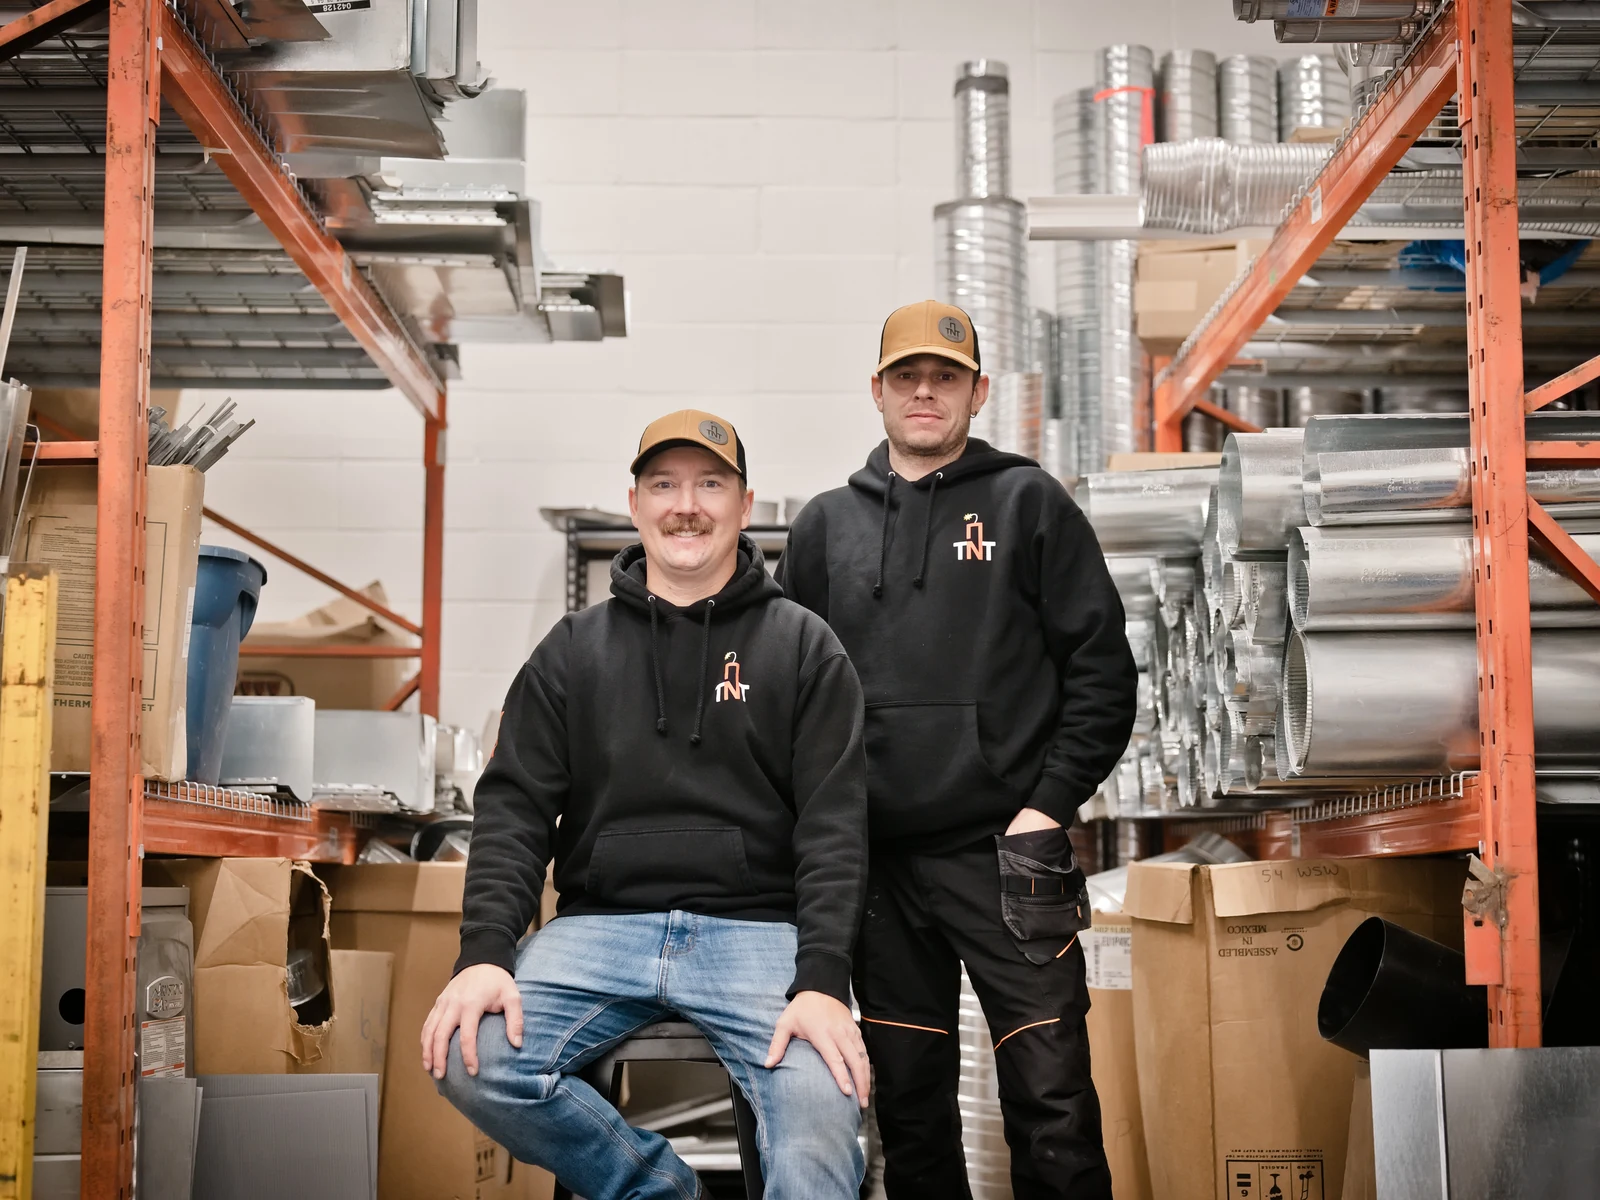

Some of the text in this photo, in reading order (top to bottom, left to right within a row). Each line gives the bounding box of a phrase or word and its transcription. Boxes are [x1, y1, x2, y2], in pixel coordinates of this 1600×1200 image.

[322, 2, 352, 12] 042128
[945, 326, 960, 337] TNT
[706, 427, 722, 439] TNT
[952, 537, 996, 561] TNT
[714, 676, 750, 702] TNT
[53, 699, 92, 708] THERM
[1296, 865, 1340, 878] WSW
[1227, 924, 1267, 934] MEXICO
[1242, 936, 1253, 945] IN
[1218, 947, 1279, 957] ASSEMBLED
